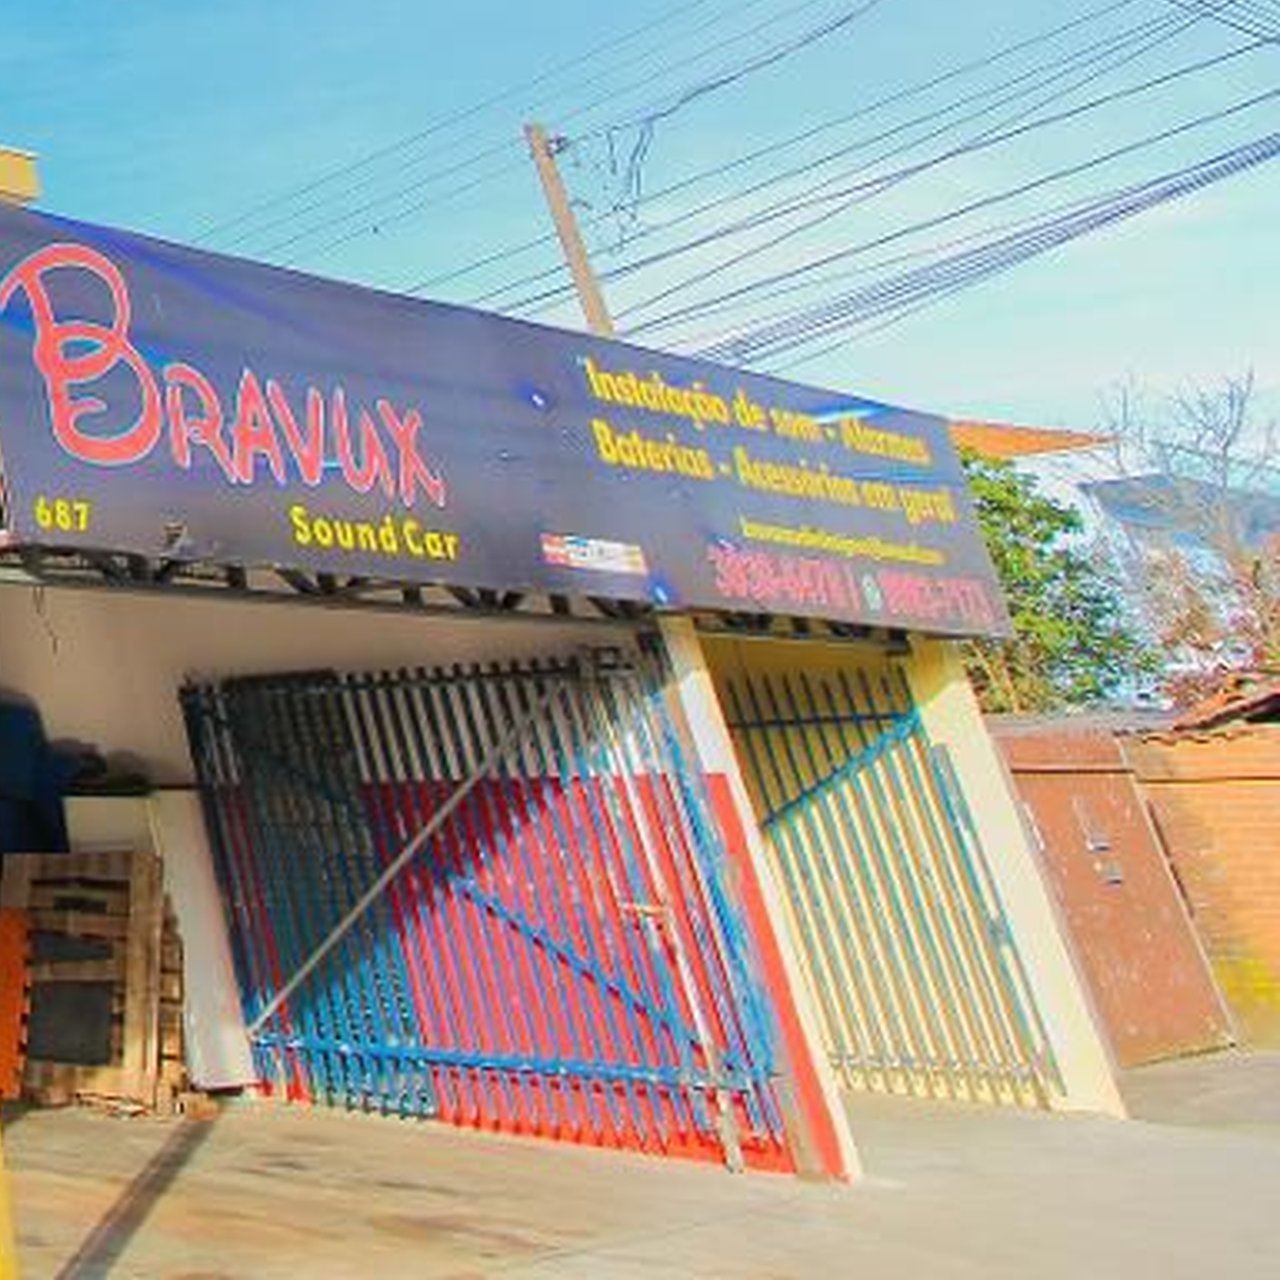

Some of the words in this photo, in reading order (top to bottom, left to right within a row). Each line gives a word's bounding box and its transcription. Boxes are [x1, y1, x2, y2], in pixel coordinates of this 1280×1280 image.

[733, 388, 768, 431] de
[591, 418, 716, 481] Baterias
[34, 496, 90, 532] 687
[289, 505, 397, 554] Sound
[401, 523, 459, 562] Car
